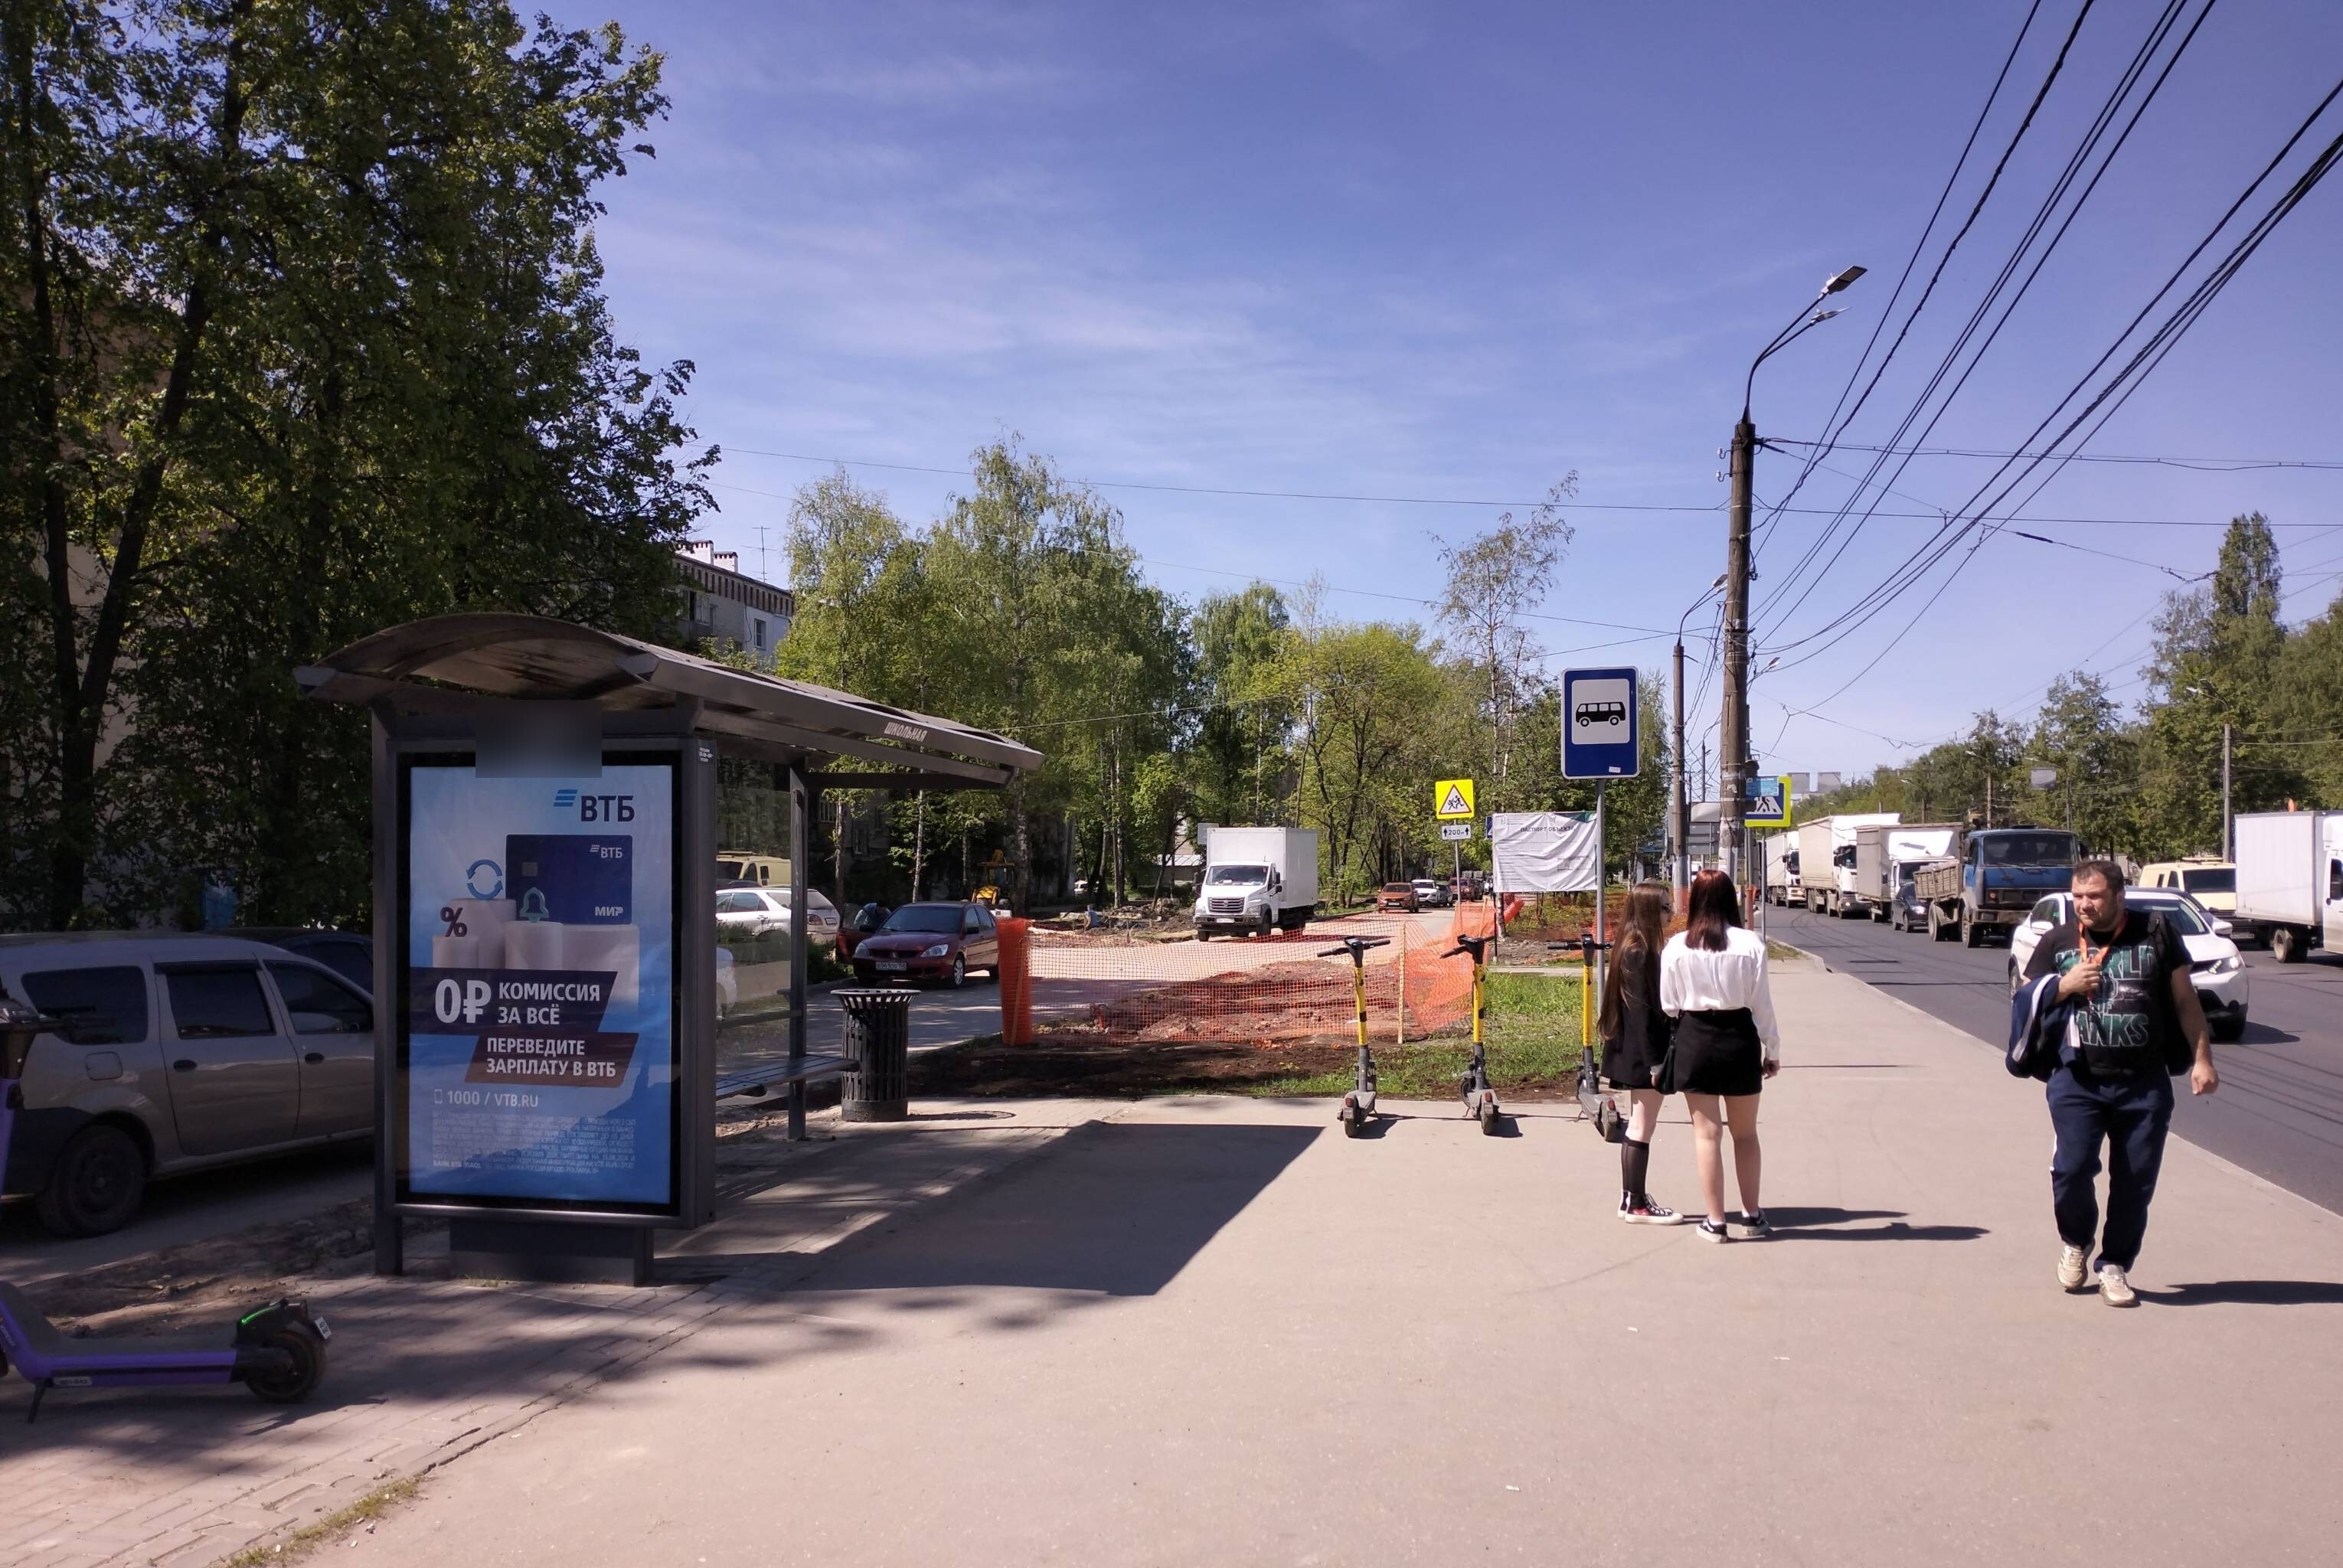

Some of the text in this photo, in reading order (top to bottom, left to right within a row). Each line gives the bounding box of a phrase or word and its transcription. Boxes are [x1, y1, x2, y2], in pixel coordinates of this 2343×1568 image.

[884, 721, 928, 742] ШКОЛЬНАЯ
[580, 795, 636, 822] ВТБ
[600, 847, 623, 859] ВТБ
[595, 906, 624, 917] МИР
[440, 906, 468, 938] %
[498, 982, 600, 1002] КОМИССИЯ
[498, 1004, 560, 1025] ЗА ВСЁ
[486, 1037, 586, 1057] ПЕРЕВЕДИТЕ
[486, 1058, 616, 1078] ЗАРПЛАТУ В ВТБ
[447, 1090, 480, 1105] 1000
[494, 1092, 539, 1108] VTB.RU
